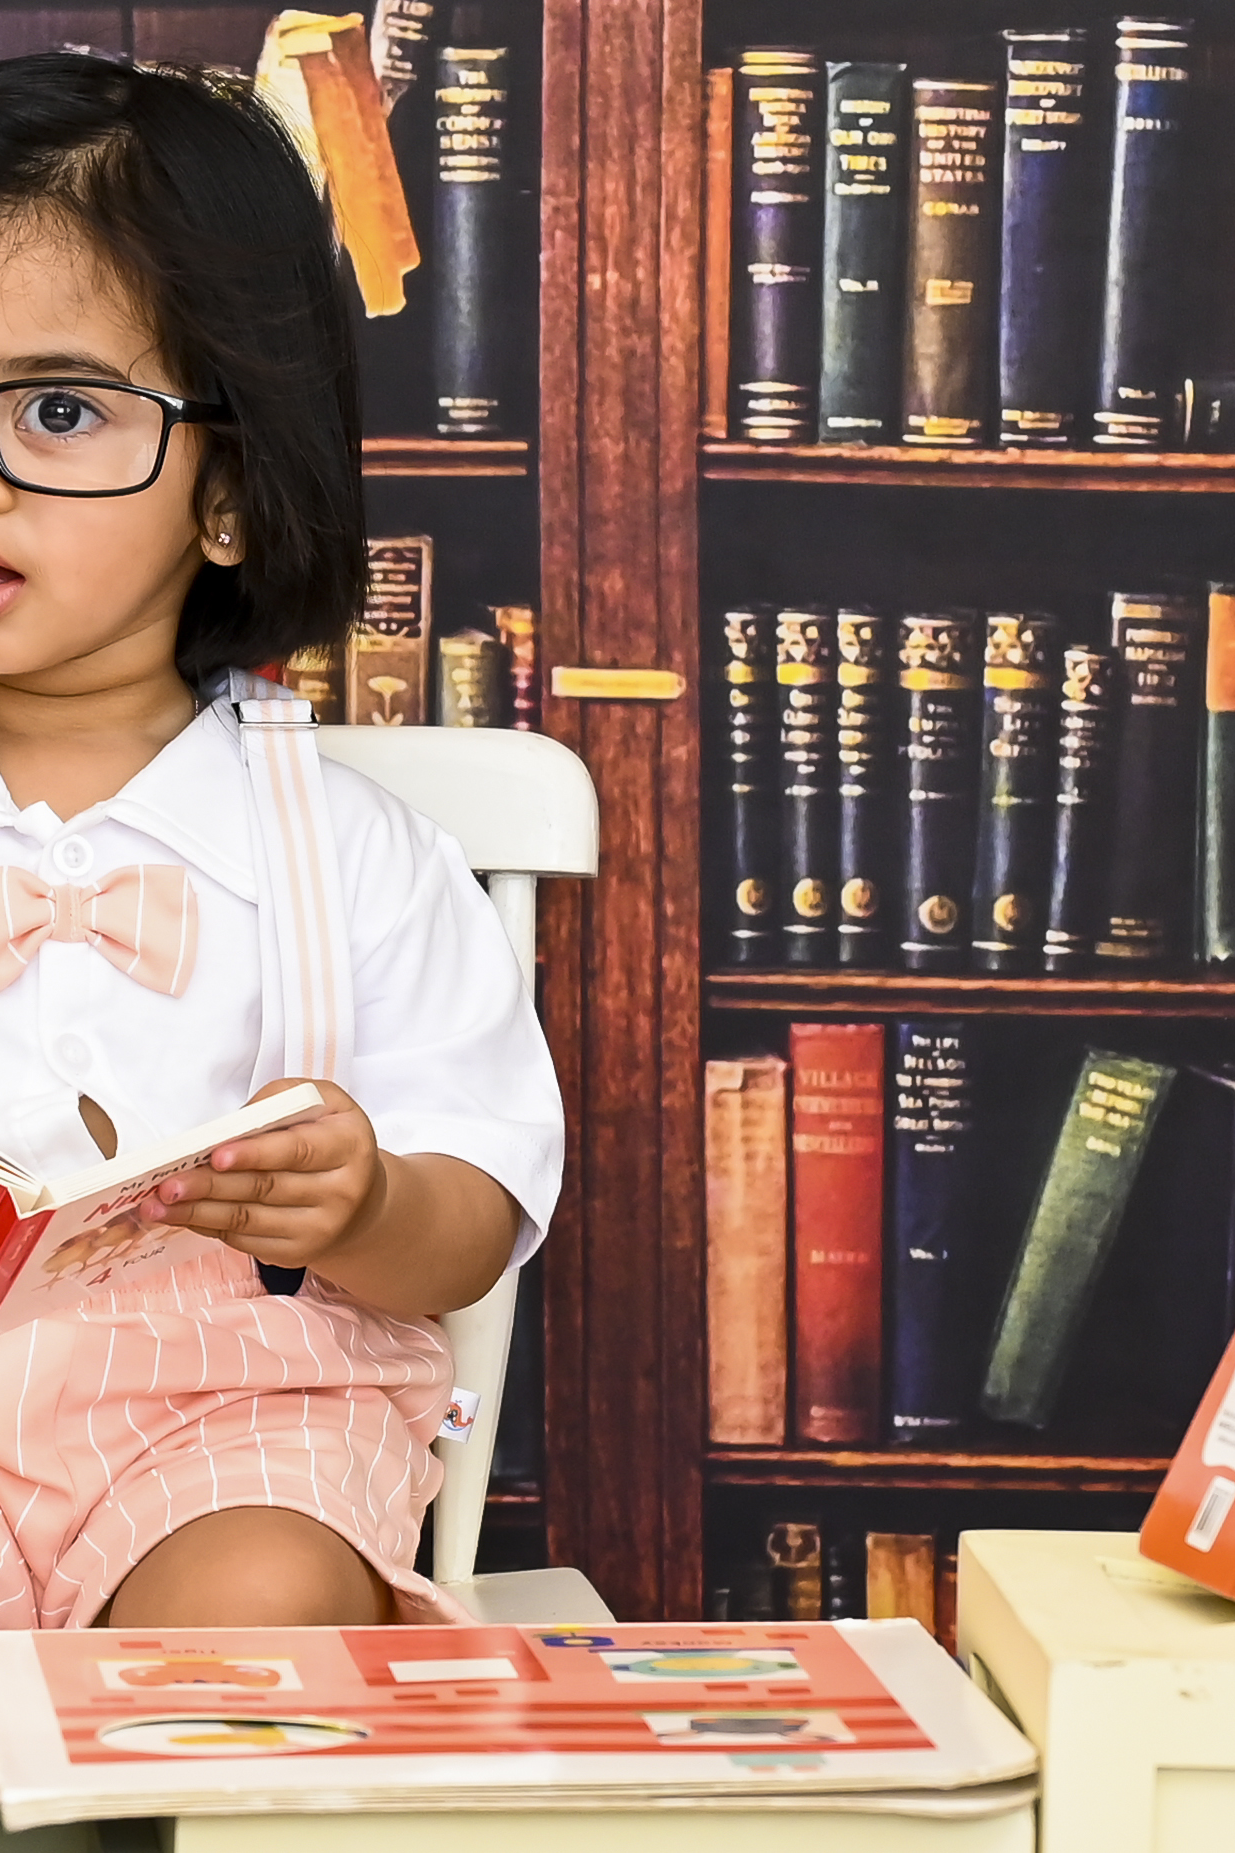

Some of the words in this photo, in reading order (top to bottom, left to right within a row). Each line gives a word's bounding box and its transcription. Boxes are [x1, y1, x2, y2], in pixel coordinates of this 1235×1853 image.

[120, 1180, 145, 1194] My
[152, 1161, 188, 1181] First
[123, 1246, 166, 1268] FOUR
[85, 1266, 113, 1287] 4
